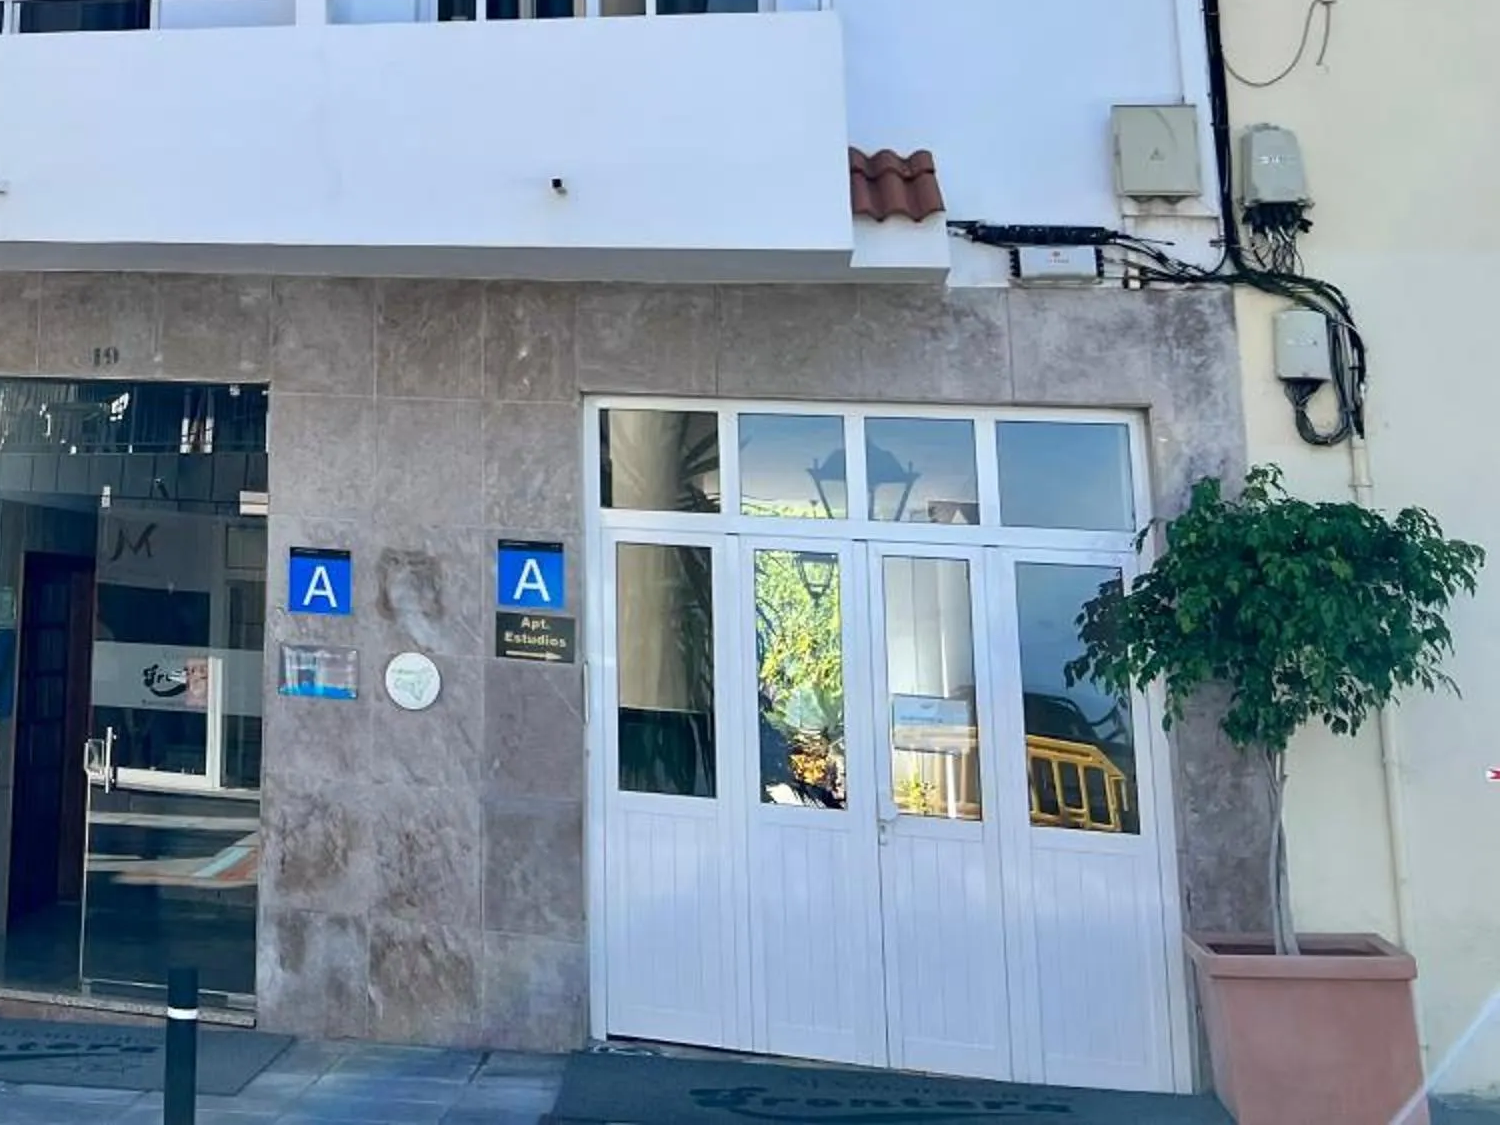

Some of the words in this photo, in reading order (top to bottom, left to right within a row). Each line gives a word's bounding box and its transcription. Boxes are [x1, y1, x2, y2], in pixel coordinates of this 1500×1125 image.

[302, 565, 338, 608] A
[513, 558, 551, 602] A
[521, 616, 551, 630] Apt.
[504, 630, 567, 648] Estudios
